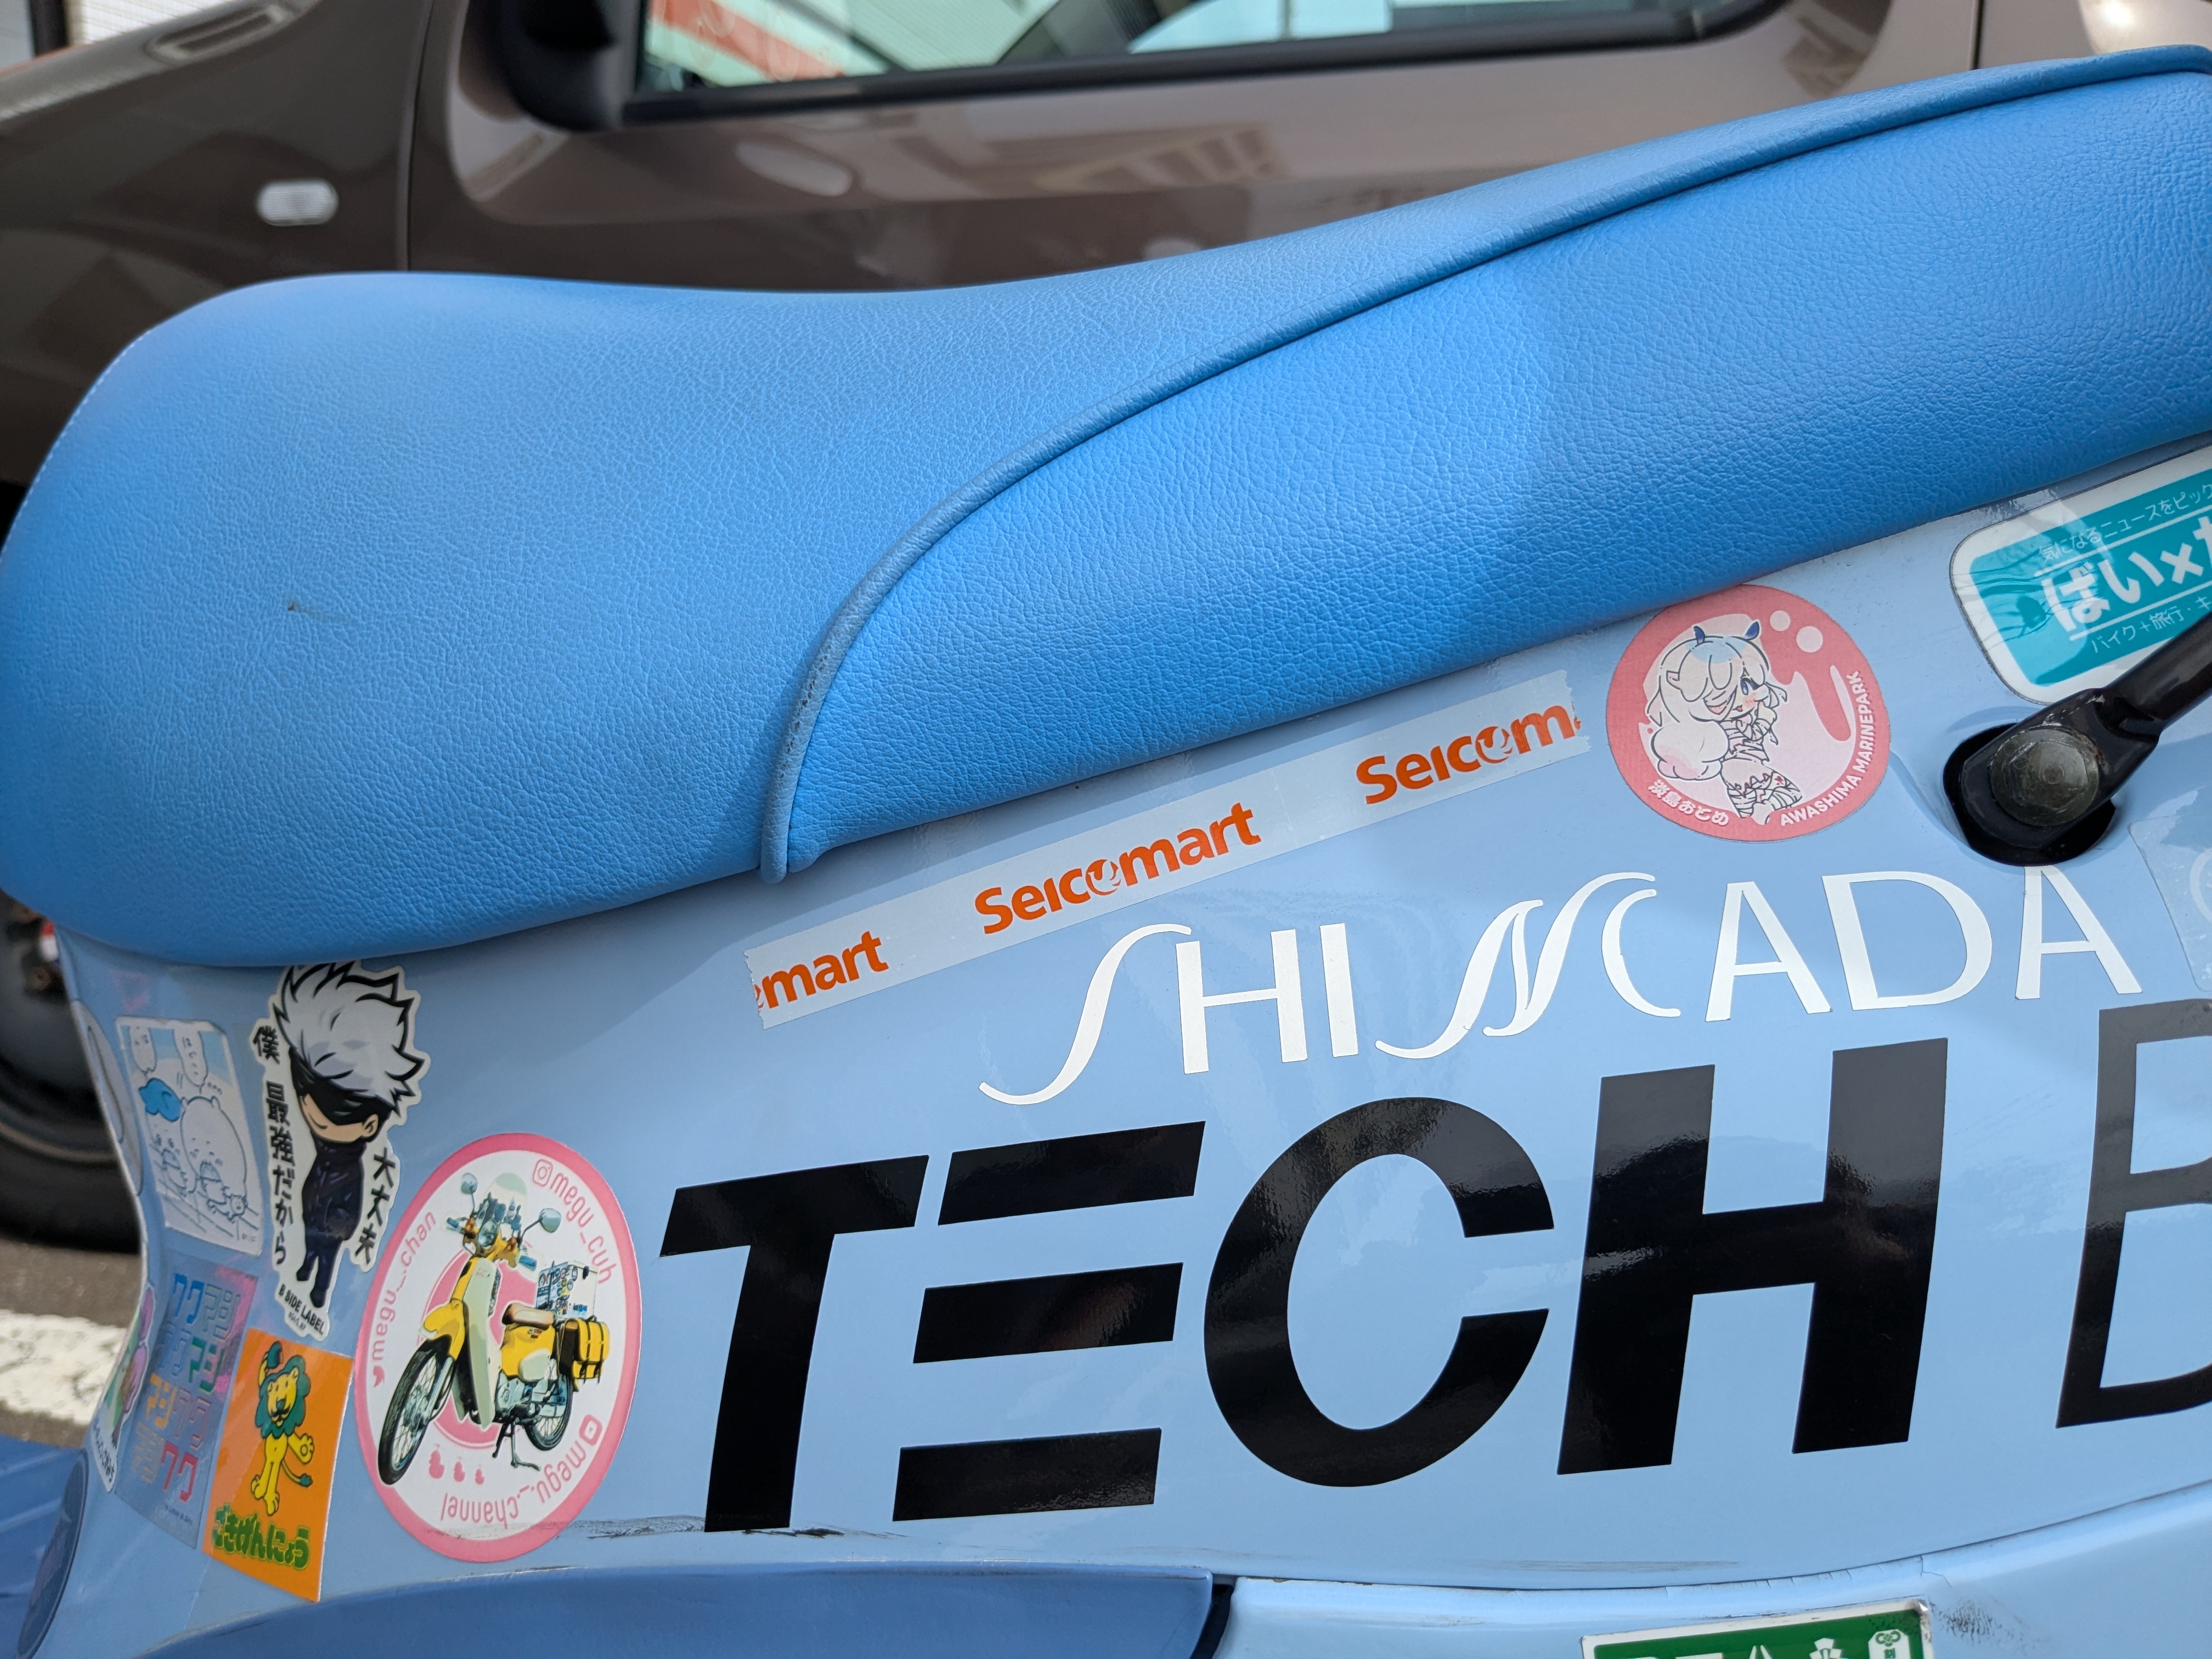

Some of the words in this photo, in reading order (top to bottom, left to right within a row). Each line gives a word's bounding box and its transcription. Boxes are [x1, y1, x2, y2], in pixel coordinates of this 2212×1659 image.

[1356, 704, 1582, 805] Seicom
[1647, 779, 1729, 826] 淡島おとめ
[1781, 775, 1861, 826] AWASHIMA
[1846, 671, 1875, 773] MARINEPARK
[974, 803, 1261, 934] Seicomart
[356, 1147, 396, 1264] 大丈夫
[279, 1284, 286, 1296] B
[285, 1289, 303, 1313] SIDE
[301, 1305, 325, 1335] LABEL
[660, 1038, 1947, 1532] TECH
